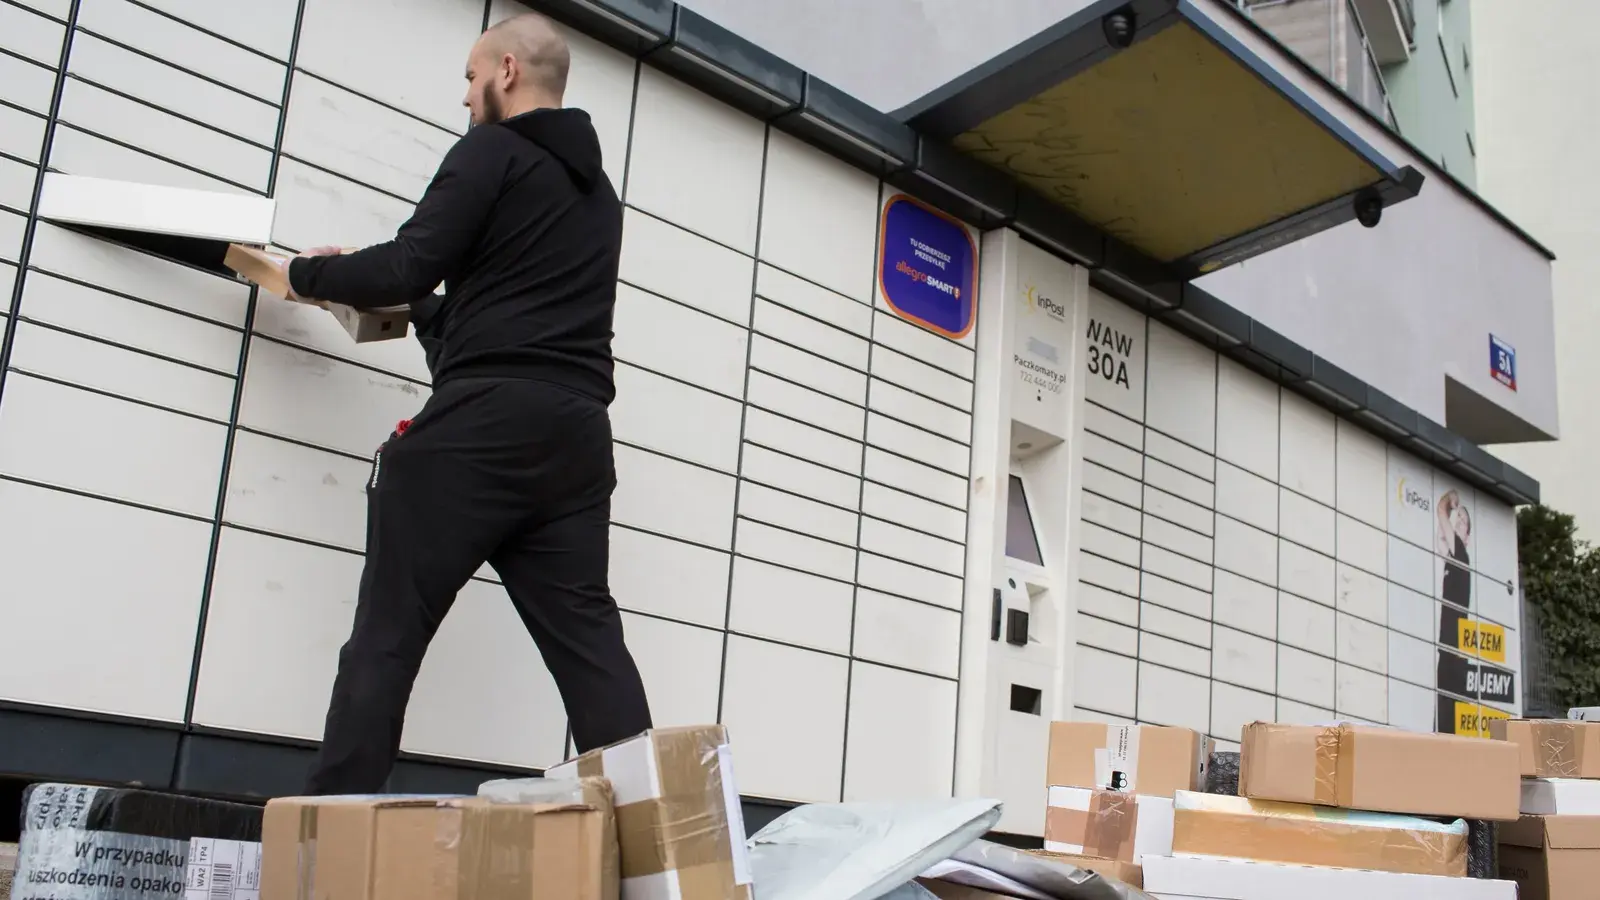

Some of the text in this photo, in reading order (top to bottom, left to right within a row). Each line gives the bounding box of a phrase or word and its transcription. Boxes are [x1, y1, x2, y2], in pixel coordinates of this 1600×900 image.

[1037, 292, 1065, 317] InPost
[1014, 354, 1067, 384] Paczkomaty.pl
[1087, 345, 1130, 390] 30A
[1405, 487, 1430, 512] InPost
[1462, 626, 1502, 653] RAZEM
[1465, 669, 1511, 696] BIJEMY
[75, 841, 92, 858] W
[93, 846, 185, 868] przypadku
[197, 846, 208, 887] WA2 TP4
[28, 867, 125, 889] uszkodzenia
